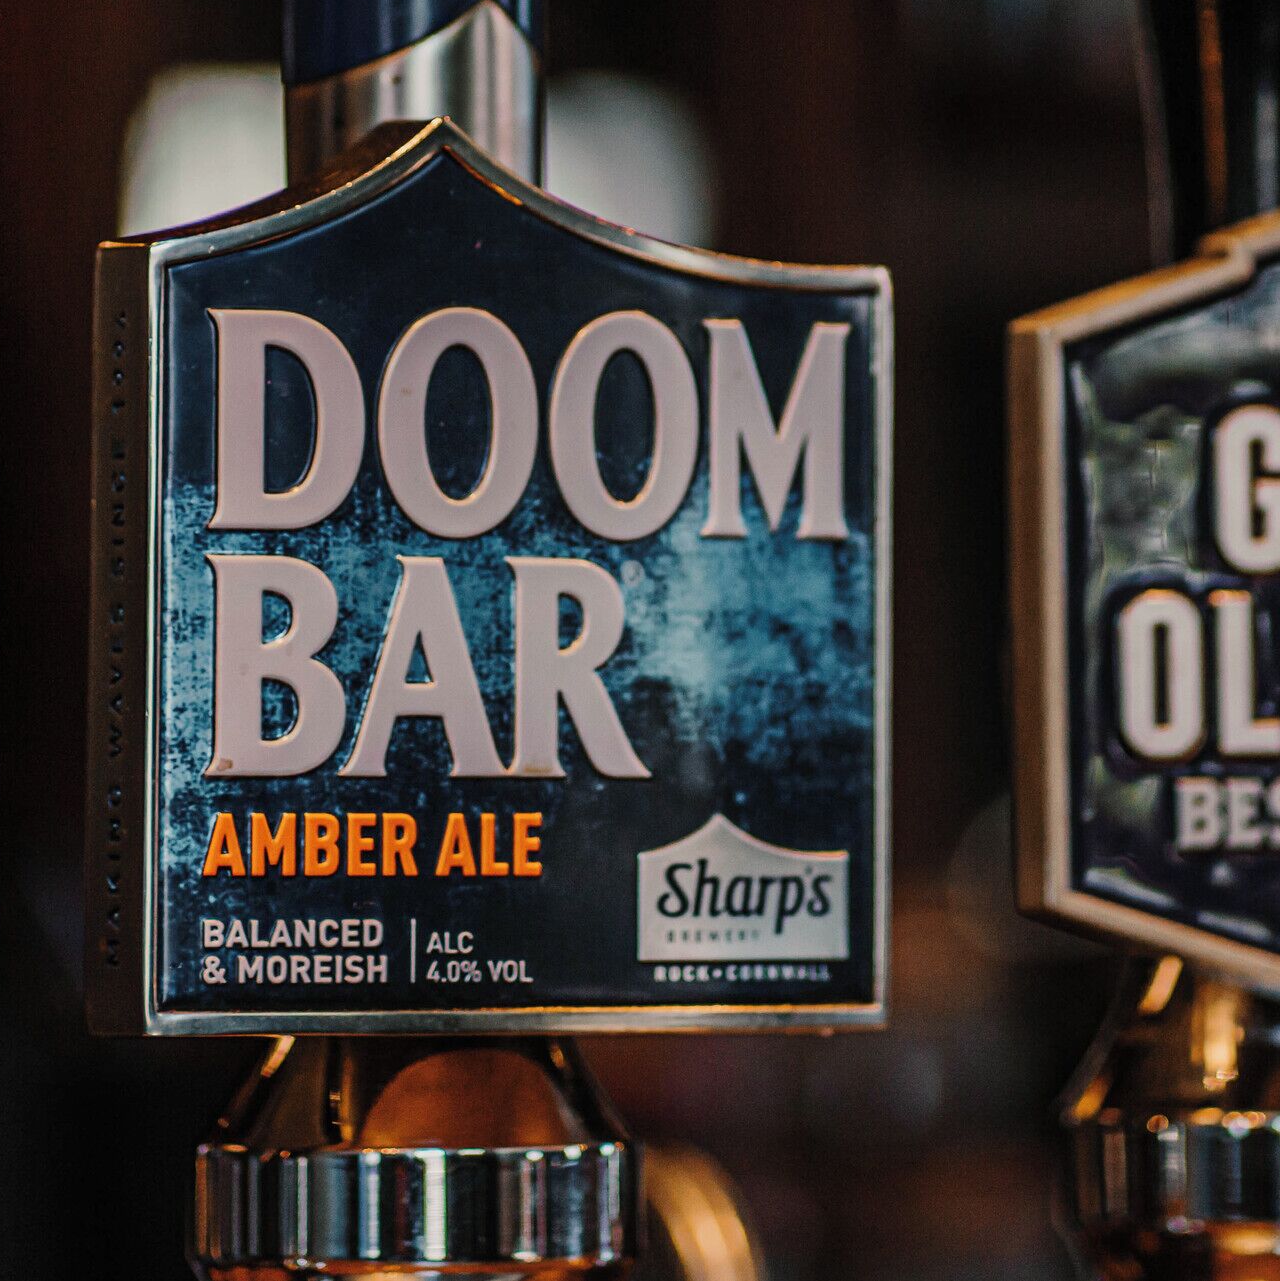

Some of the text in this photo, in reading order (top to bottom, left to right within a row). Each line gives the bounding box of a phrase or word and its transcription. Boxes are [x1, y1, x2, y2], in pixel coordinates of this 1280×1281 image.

[206, 306, 851, 541] DOOM
[203, 554, 652, 779] BAR
[202, 812, 544, 877] AMBER ALE
[656, 858, 833, 936] Sharp's
[203, 919, 384, 949] BALANCED
[426, 931, 475, 954] ALC
[202, 955, 388, 985] & MOREISH
[426, 960, 535, 983] 4.0% VOL
